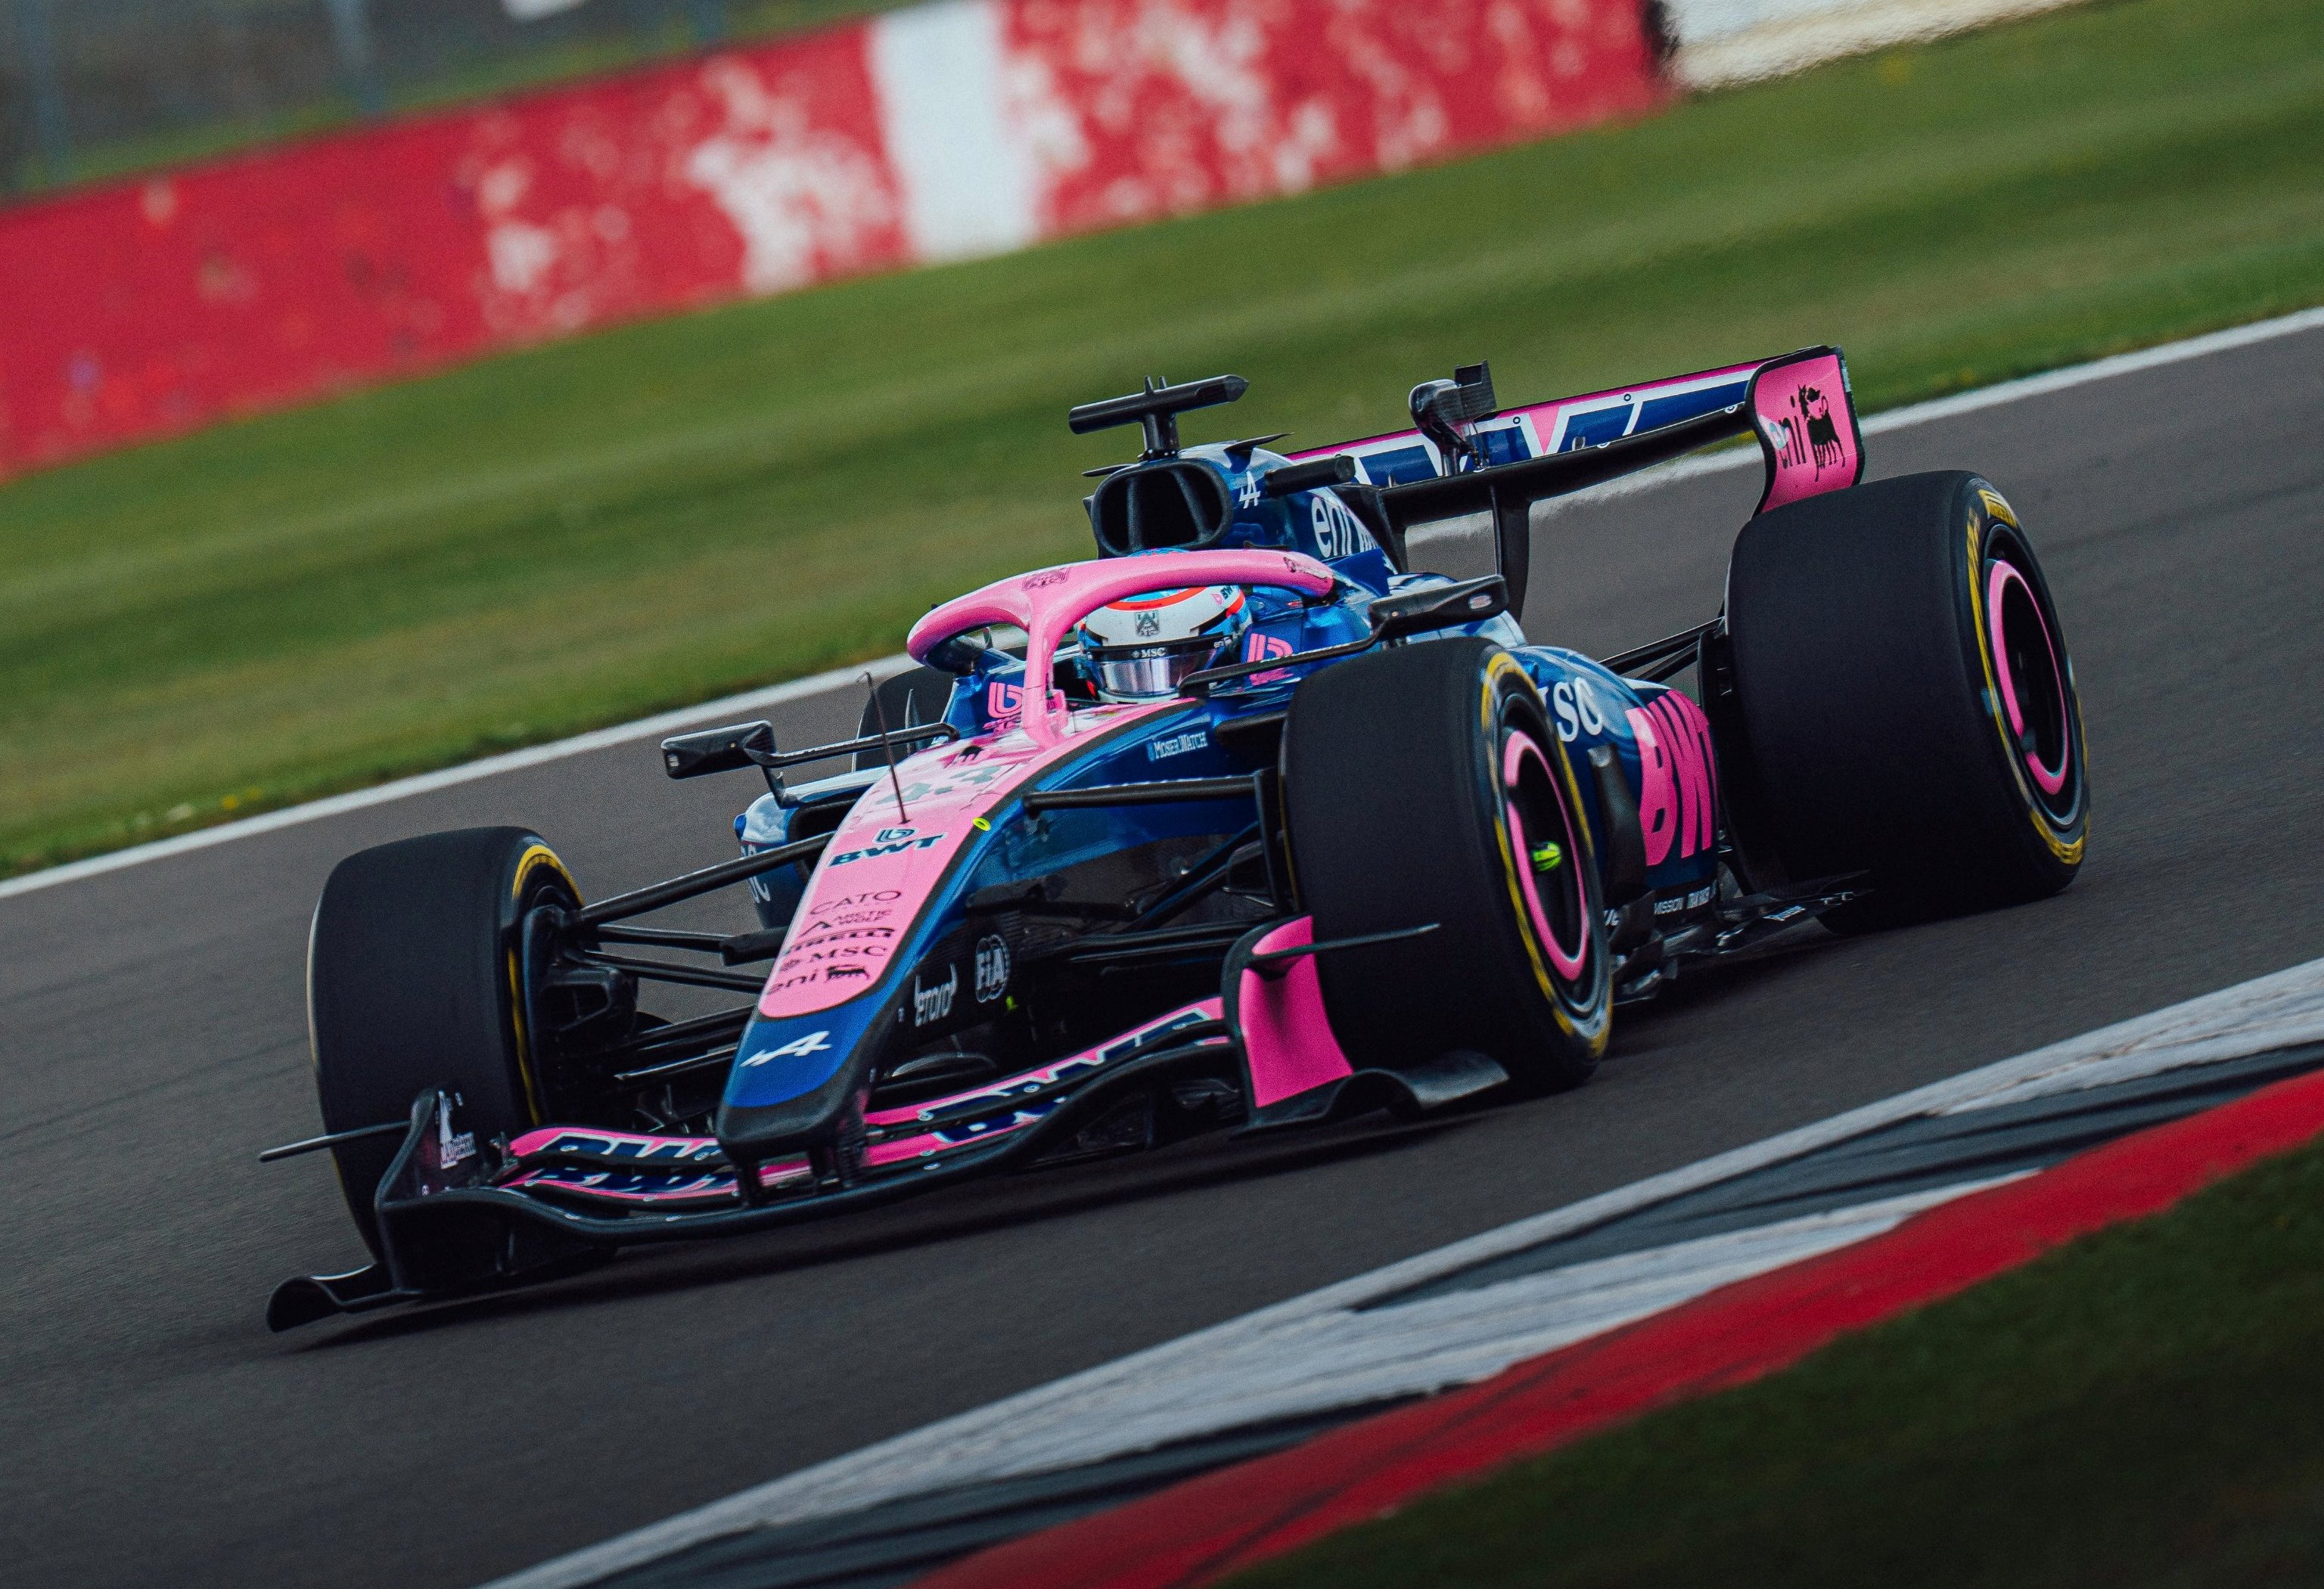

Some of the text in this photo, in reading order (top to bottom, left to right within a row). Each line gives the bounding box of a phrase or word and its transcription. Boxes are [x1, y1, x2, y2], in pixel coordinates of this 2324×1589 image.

[1141, 648, 1167, 658] MSC
[1537, 677, 1603, 742] SC
[828, 833, 946, 867] BWT
[810, 890, 901, 915] CATO
[809, 946, 887, 964] MSC
